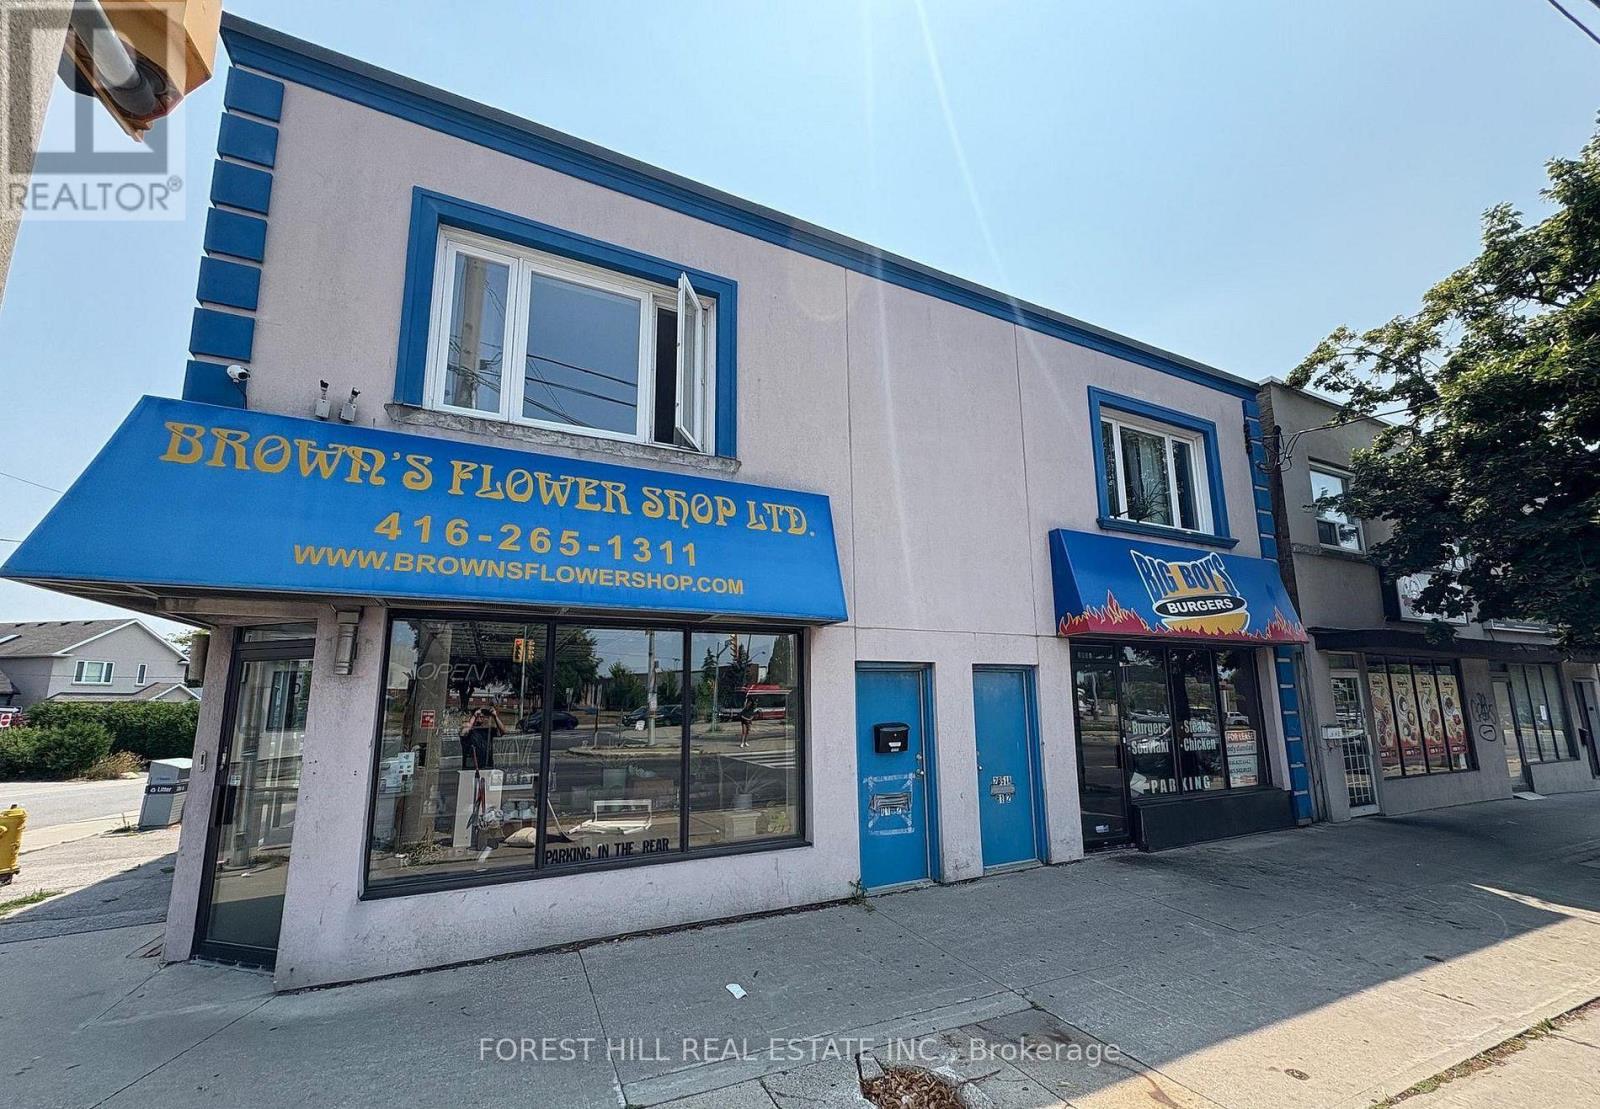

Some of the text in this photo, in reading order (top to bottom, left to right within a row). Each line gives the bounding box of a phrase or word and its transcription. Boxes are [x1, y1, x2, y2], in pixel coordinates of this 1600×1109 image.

[159, 421, 815, 537] BROWN'S FLOWER SHOP LTD.
[373, 512, 697, 566] 416-265-1311
[293, 544, 745, 595] WWW.BROWNSFLOWERSHOP.COM
[1130, 549, 1180, 605] BIG
[1166, 598, 1234, 614] BURGERS
[416, 662, 489, 681] OPEN
[1183, 738, 1217, 751] Chicken
[1151, 775, 1211, 793] PARKING
[544, 837, 670, 864] PARKING IN THE REAR
